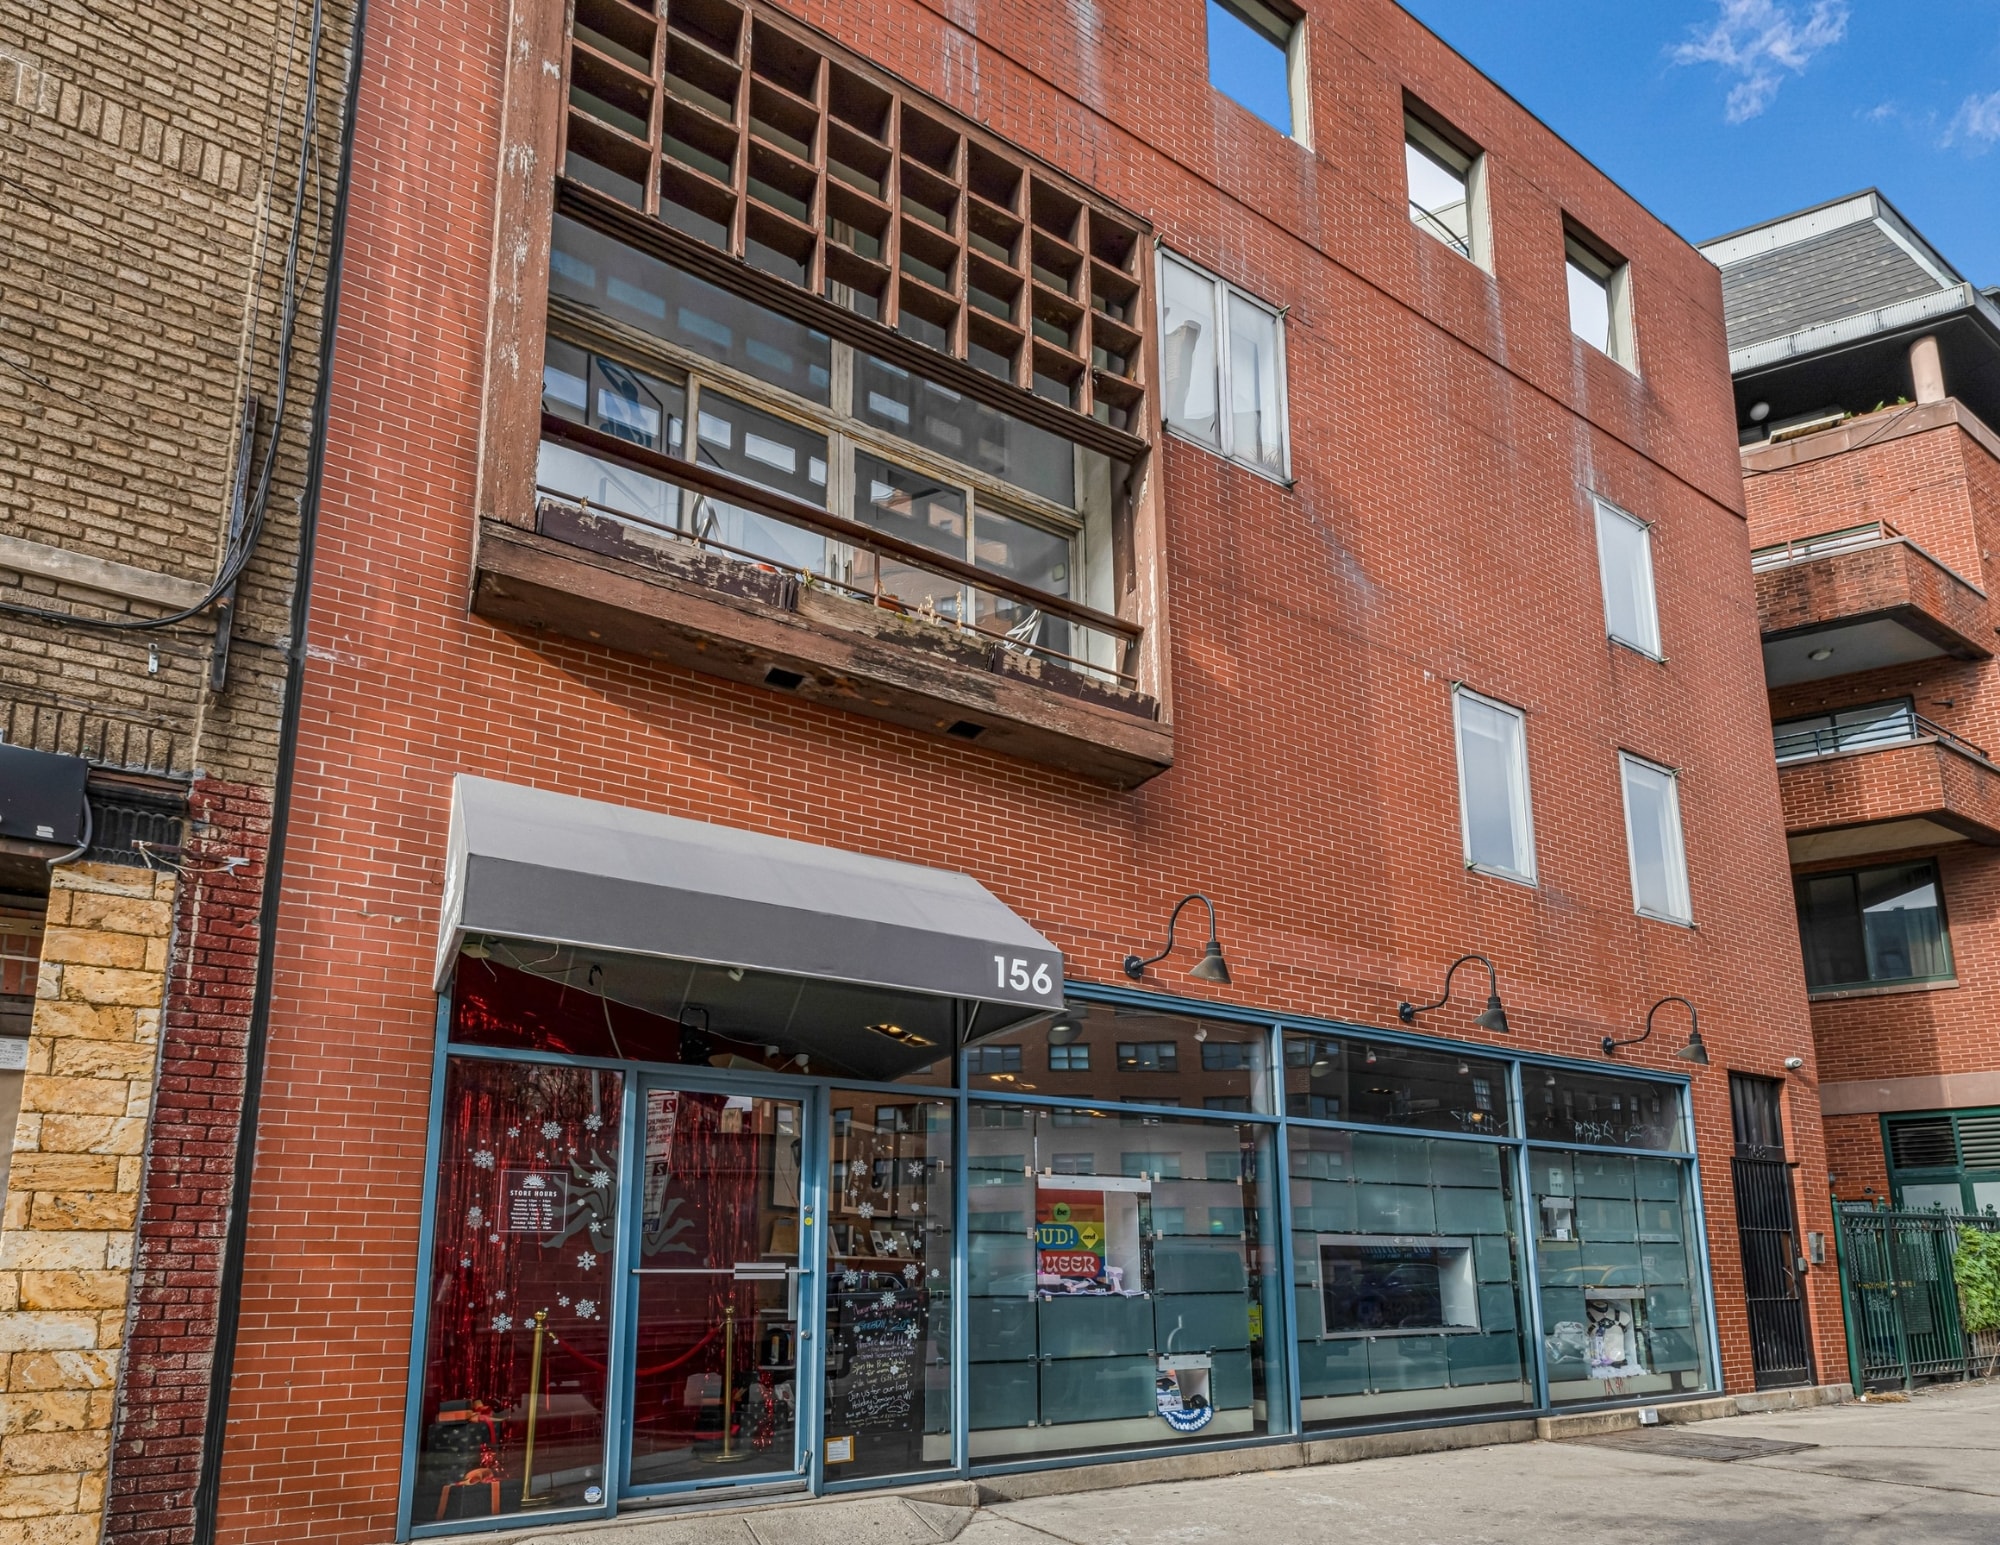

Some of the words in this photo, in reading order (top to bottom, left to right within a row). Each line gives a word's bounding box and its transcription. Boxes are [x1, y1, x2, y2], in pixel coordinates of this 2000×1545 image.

[994, 955, 1053, 995] 156
[510, 1189, 532, 1197] STORE
[534, 1190, 557, 1198] HOURS
[1056, 1207, 1068, 1216] be
[1082, 1232, 1096, 1240] and
[870, 1384, 881, 1395] for
[882, 1386, 895, 1394] our
[895, 1380, 909, 1391] last
